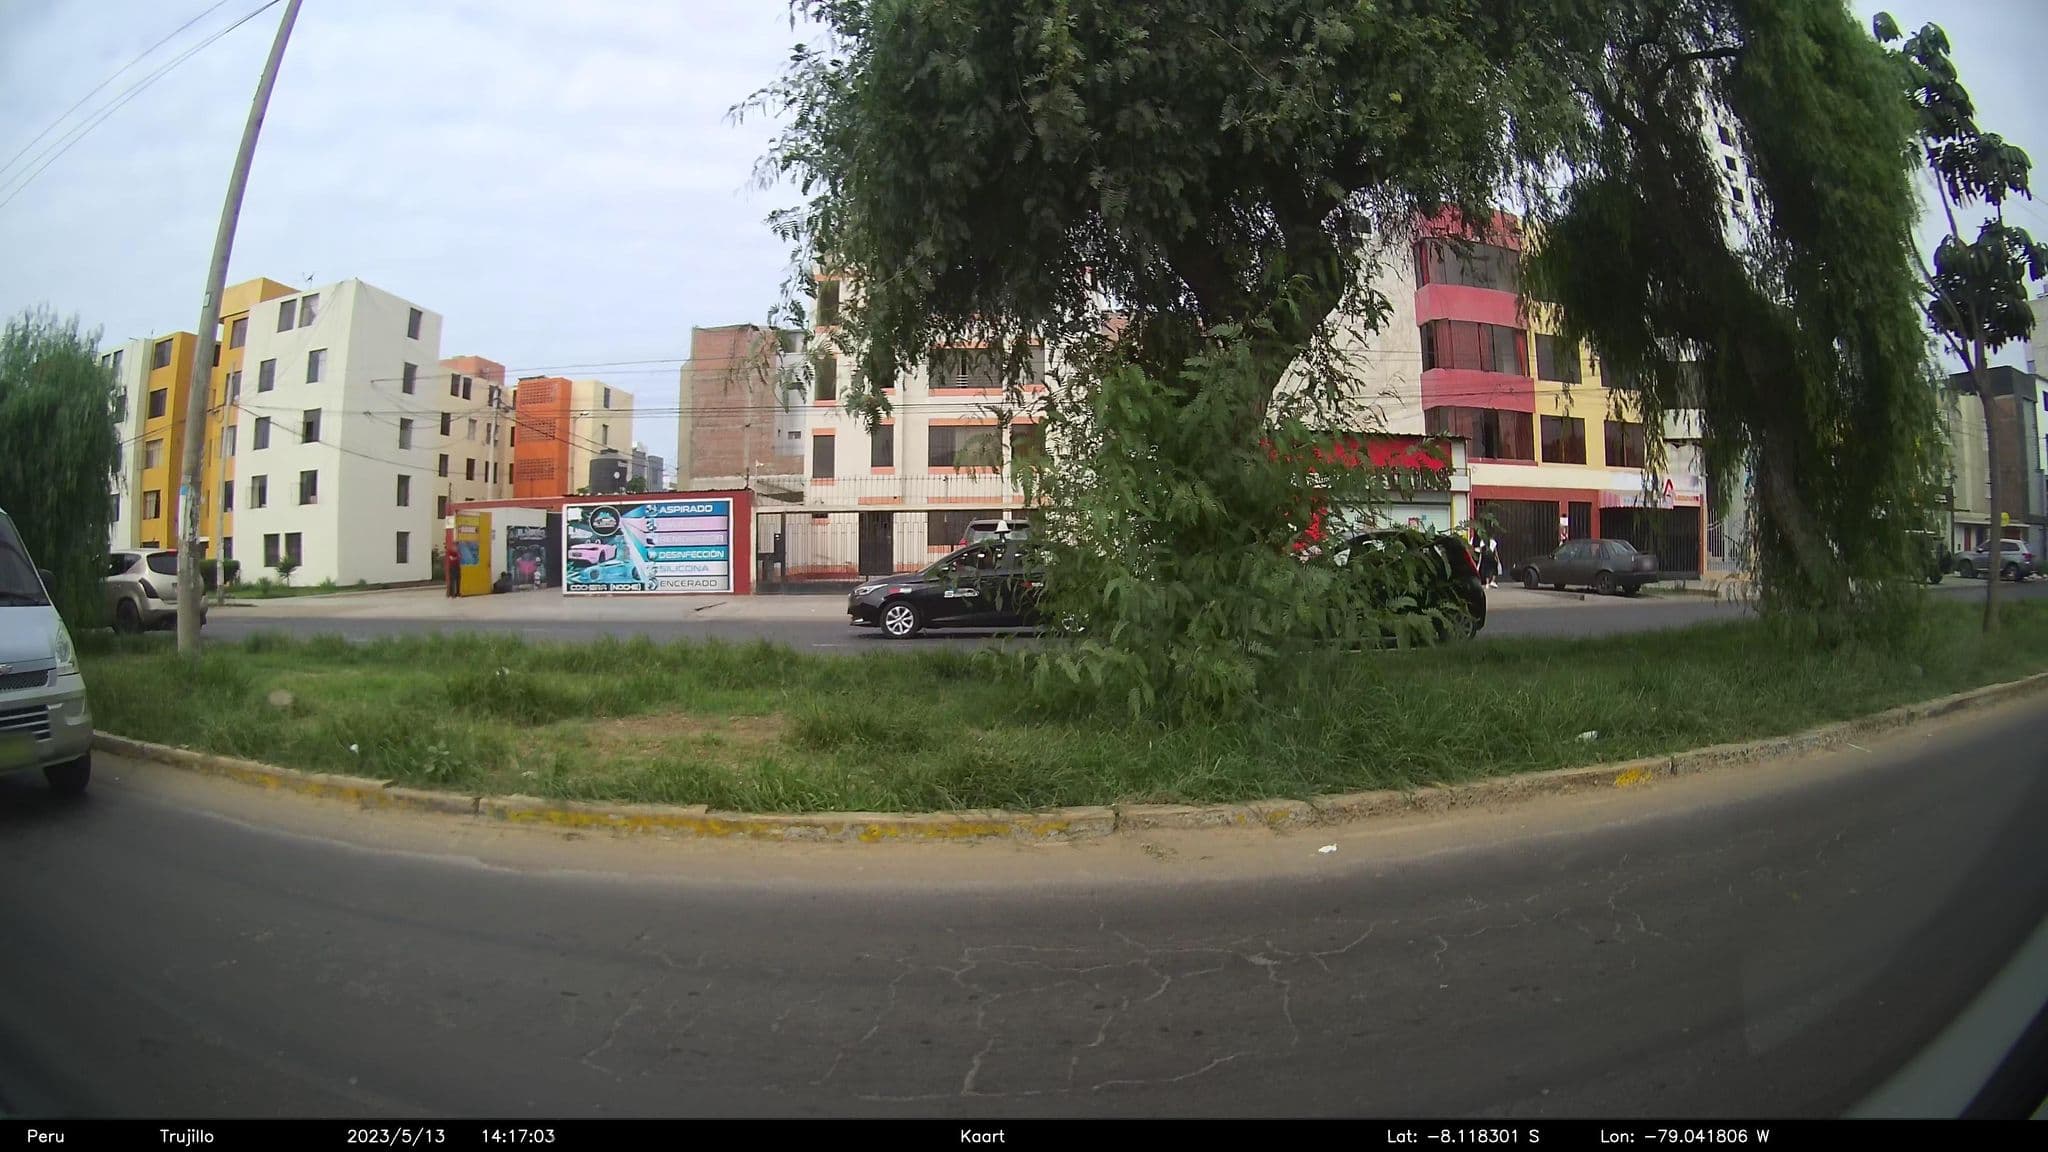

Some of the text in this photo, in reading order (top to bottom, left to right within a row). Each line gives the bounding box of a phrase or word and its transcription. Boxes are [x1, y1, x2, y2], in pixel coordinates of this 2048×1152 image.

[659, 505, 713, 513] ASPIRADO
[660, 564, 710, 573] SILICONA
[660, 580, 718, 588] ENCERADO
